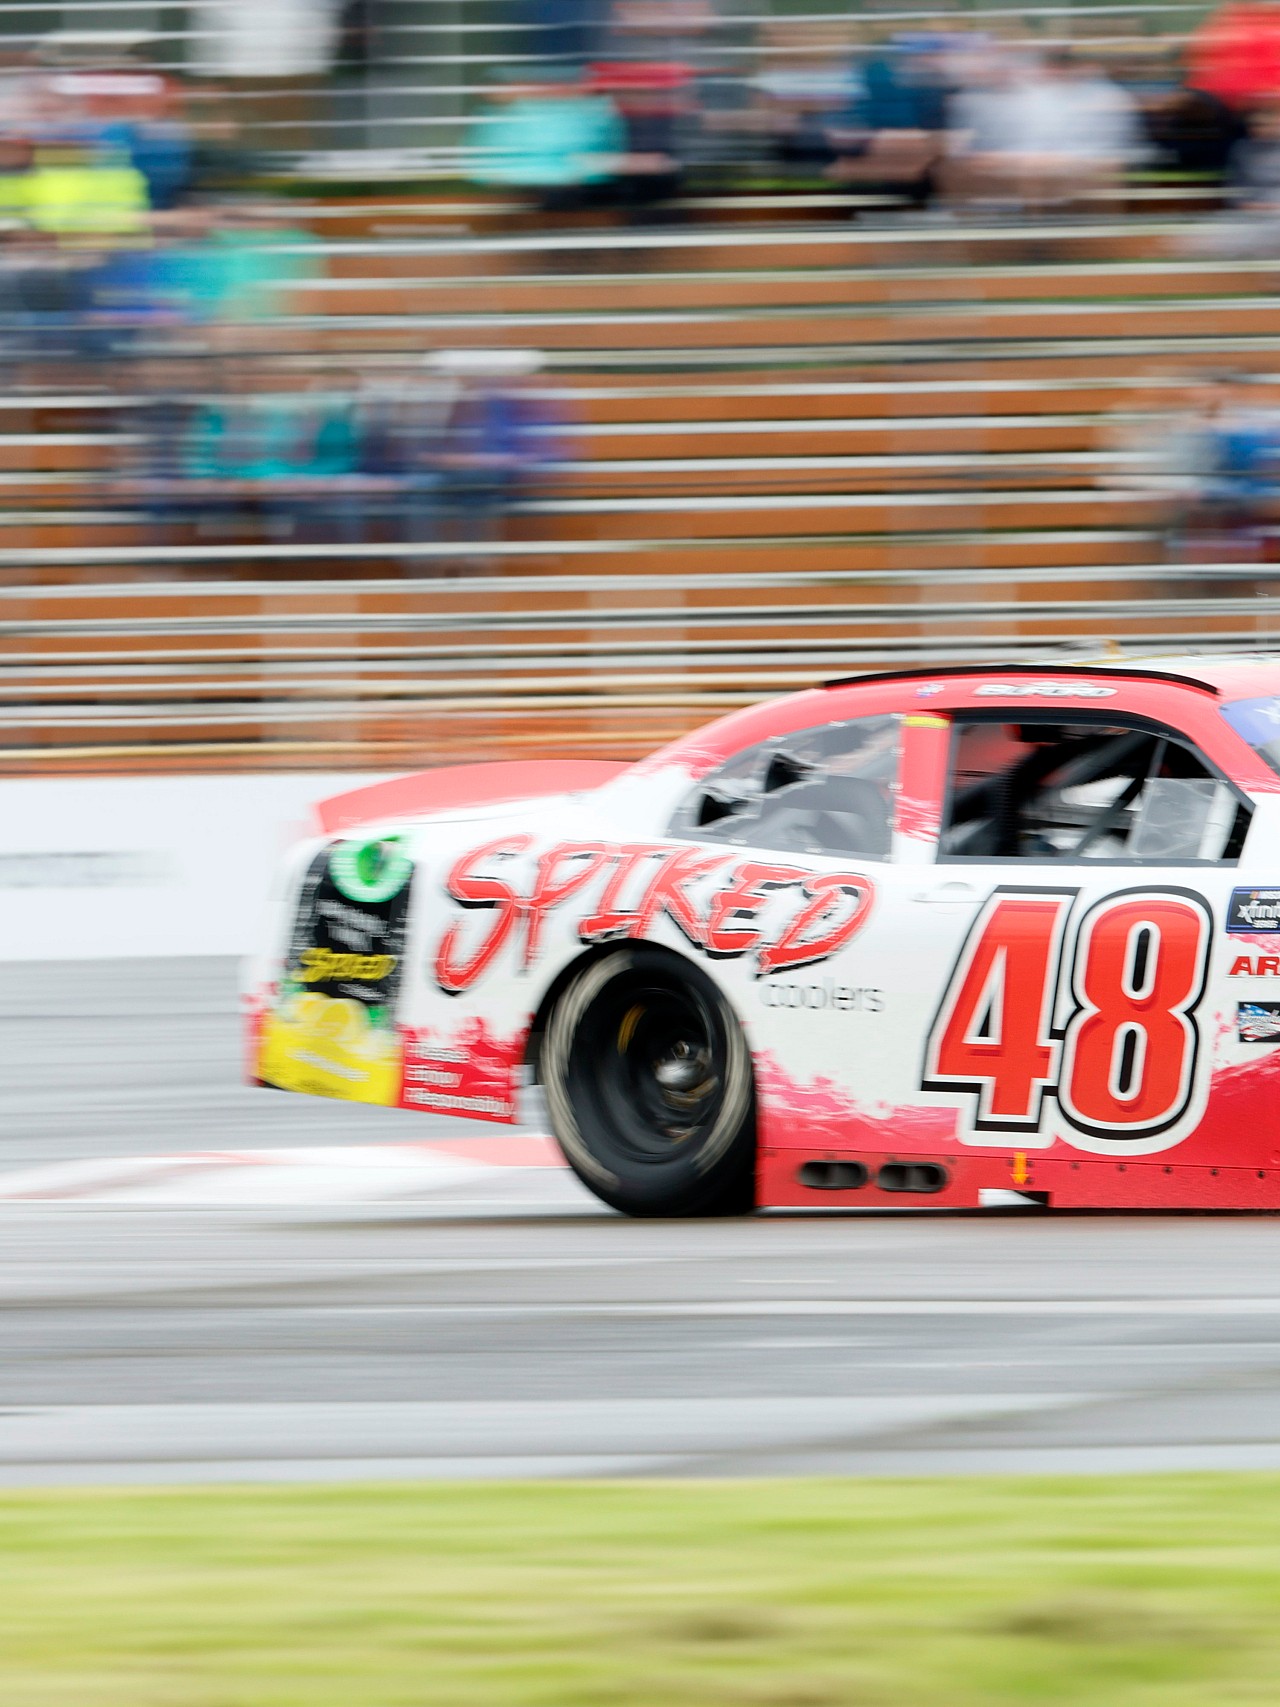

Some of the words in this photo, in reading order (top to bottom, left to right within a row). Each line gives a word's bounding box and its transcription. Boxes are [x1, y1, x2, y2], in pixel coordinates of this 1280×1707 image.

[433, 833, 878, 996] SPIKED
[760, 976, 886, 1013] coolers
[920, 885, 1215, 1141] 48
